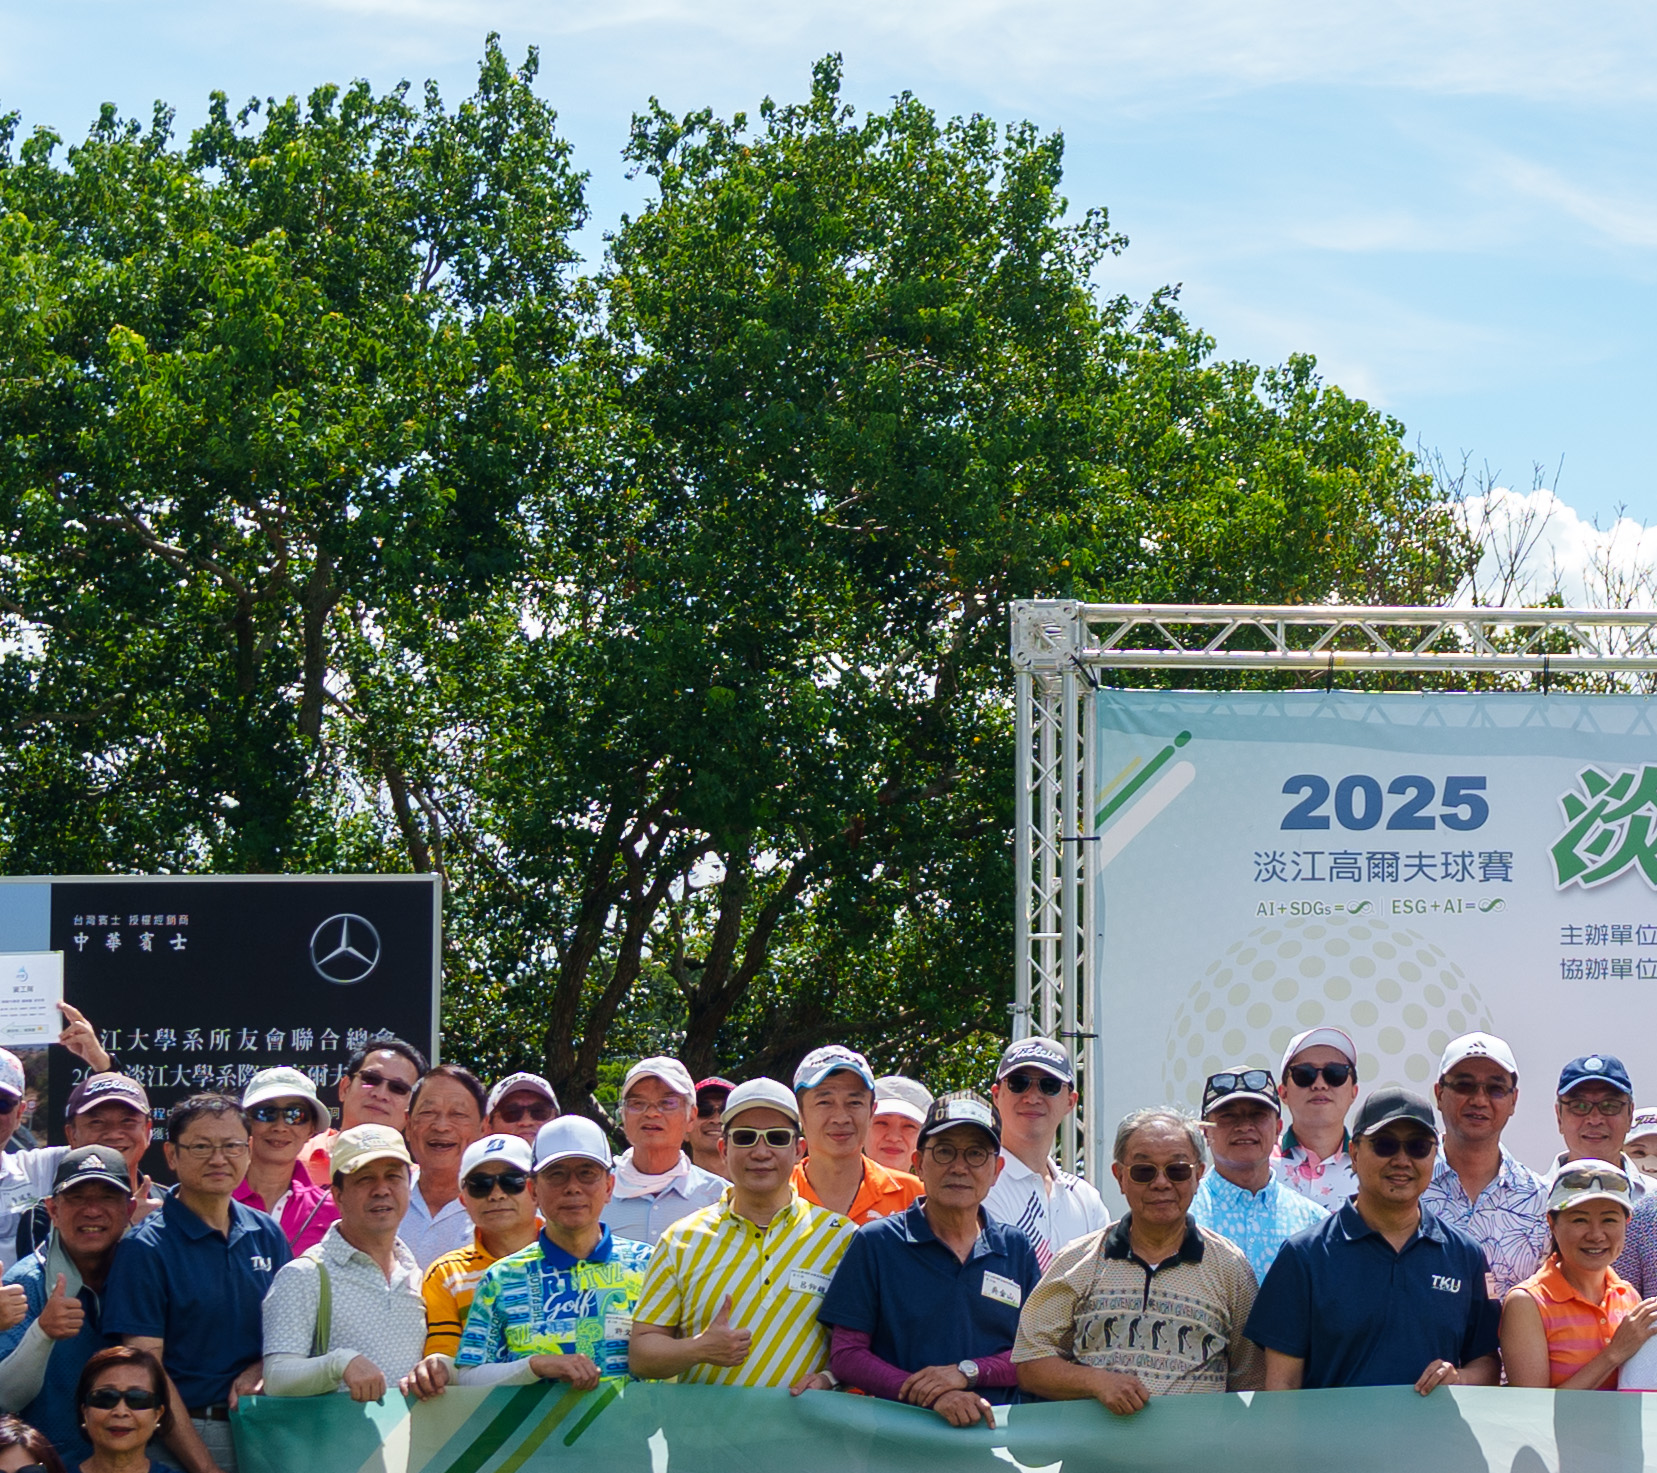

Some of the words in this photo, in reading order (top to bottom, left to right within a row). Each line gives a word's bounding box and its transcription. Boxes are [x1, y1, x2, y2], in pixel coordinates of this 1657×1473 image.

[1279, 774, 1490, 831] 2025
[1253, 850, 1513, 883] 淡江高爾夫球賽
[73, 932, 188, 952] 中華賓士
[100, 1028, 395, 1052] 江大學系所友會聯合總會
[1007, 1045, 1065, 1063] Titleist
[1432, 1274, 1462, 1293] TKU
[544, 1289, 596, 1321] Golf
